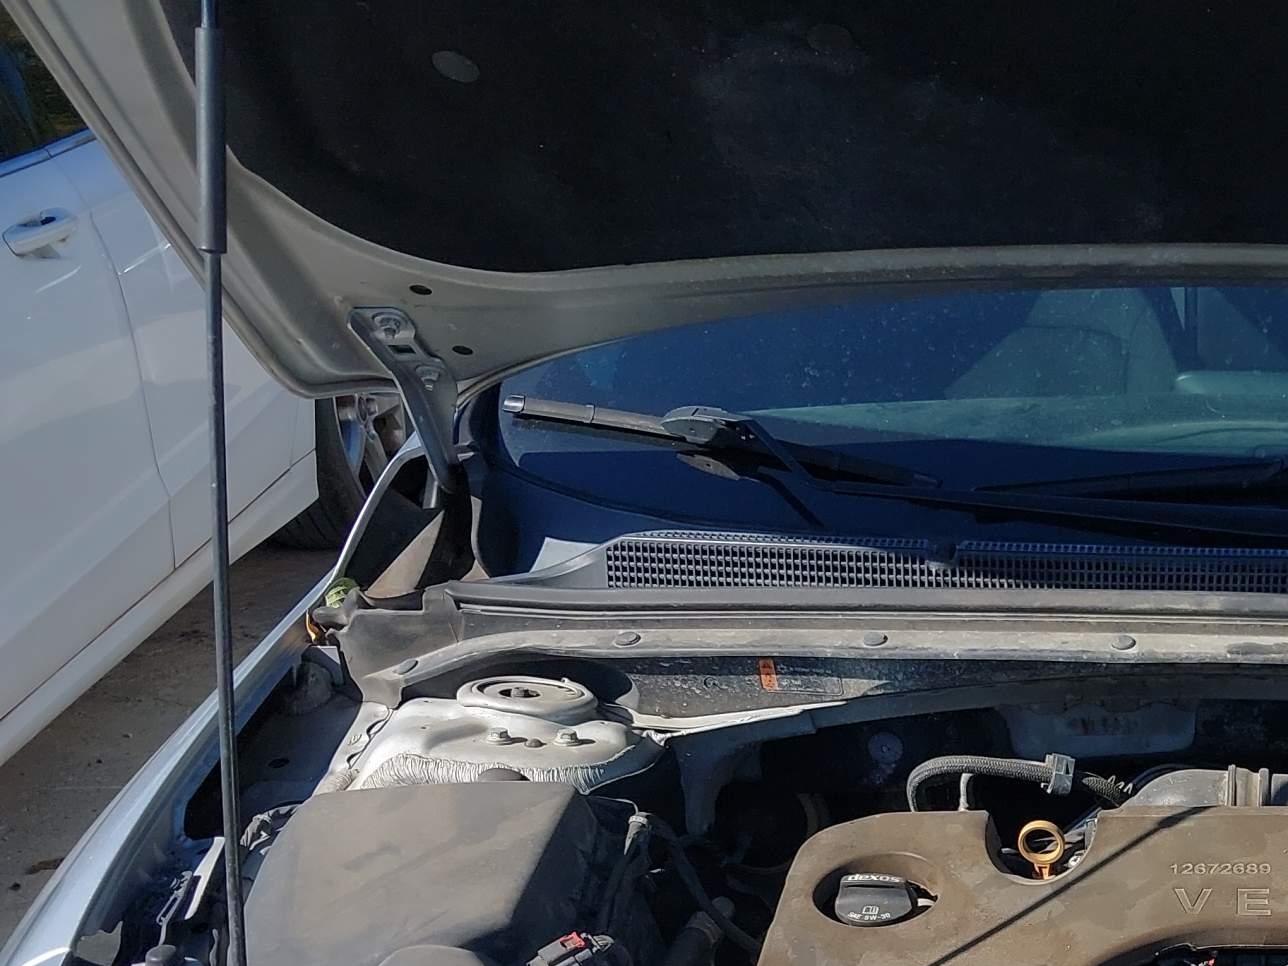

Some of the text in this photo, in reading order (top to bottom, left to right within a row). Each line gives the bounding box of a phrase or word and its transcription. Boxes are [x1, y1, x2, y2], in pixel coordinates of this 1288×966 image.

[1170, 863, 1271, 875] 12672689
[848, 874, 903, 882] dexos
[1174, 888, 1272, 916] V E
